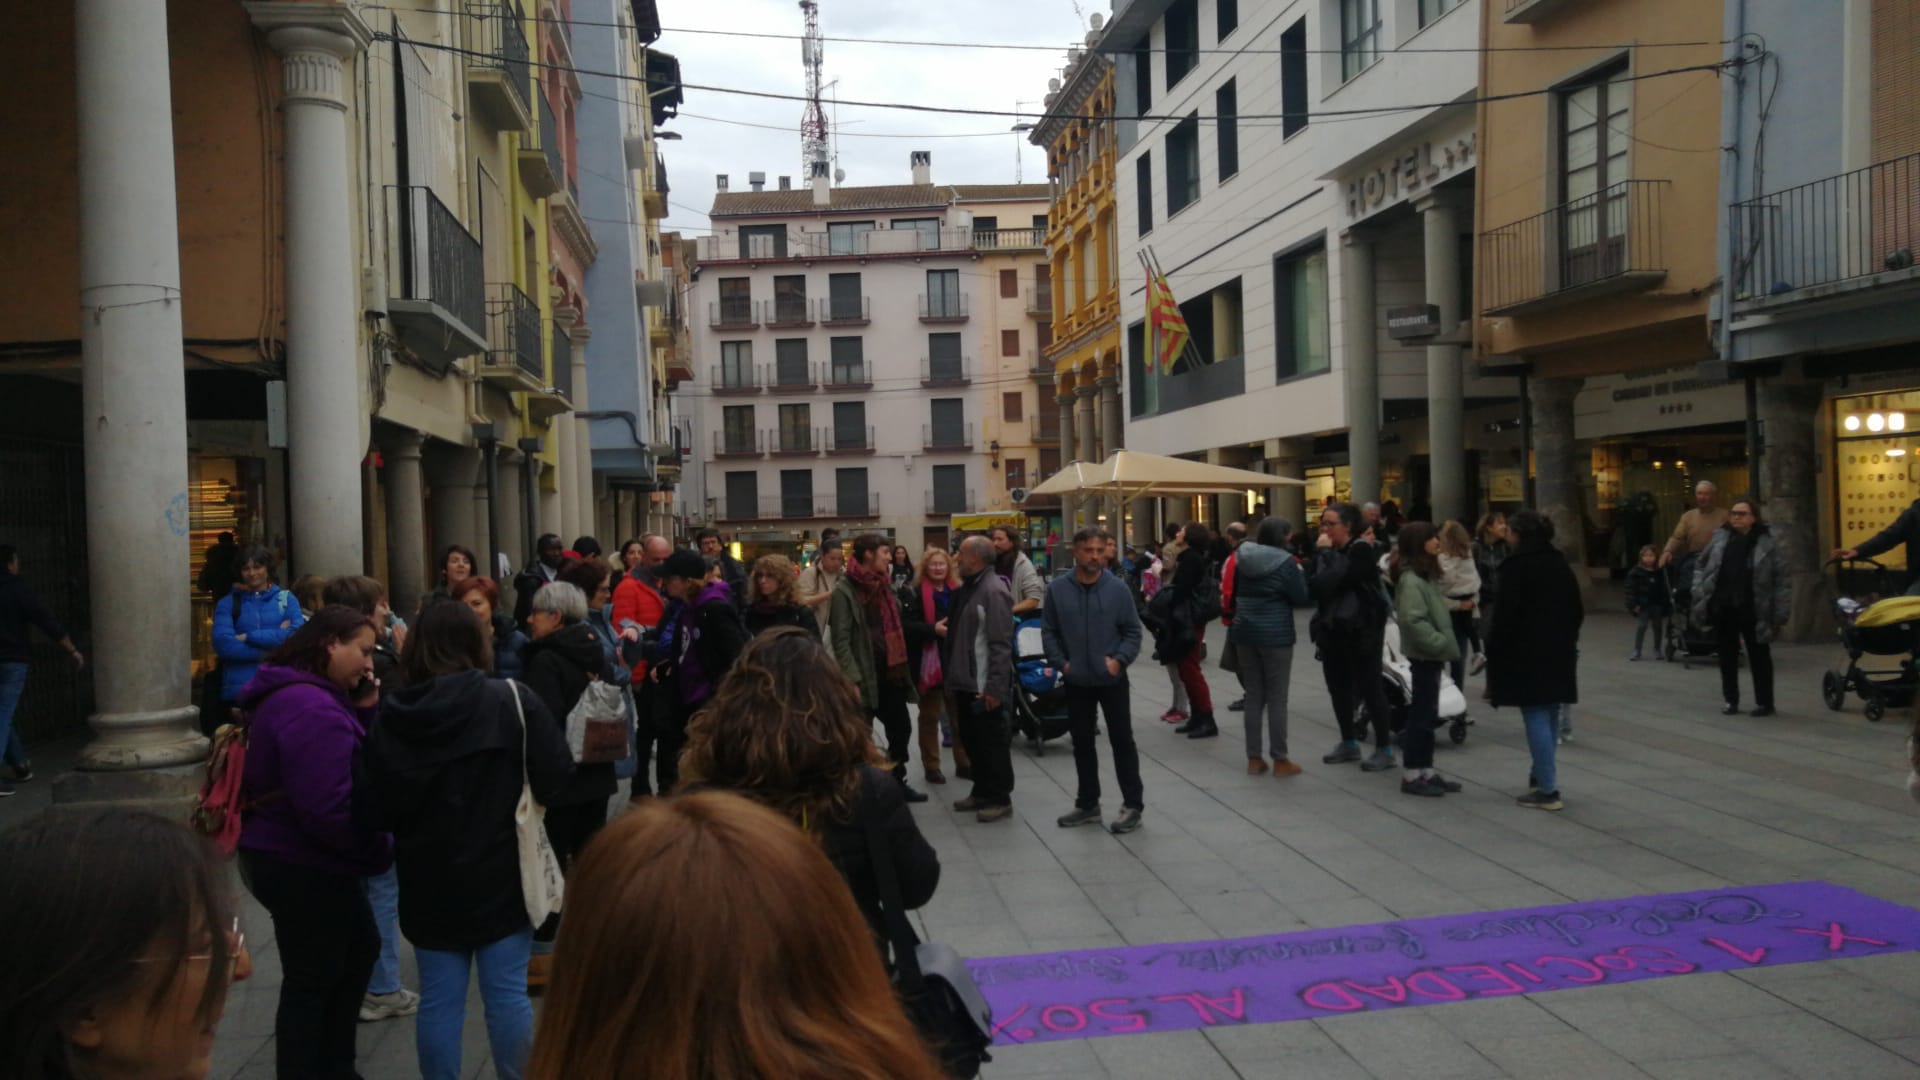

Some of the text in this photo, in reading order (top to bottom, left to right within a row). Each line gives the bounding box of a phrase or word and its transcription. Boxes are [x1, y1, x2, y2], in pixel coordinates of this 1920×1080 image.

[1348, 142, 1439, 218] HOTEL
[990, 517, 1016, 527] CASA
[991, 997, 1149, 1039] 50%
[1156, 989, 1246, 1023] AL
